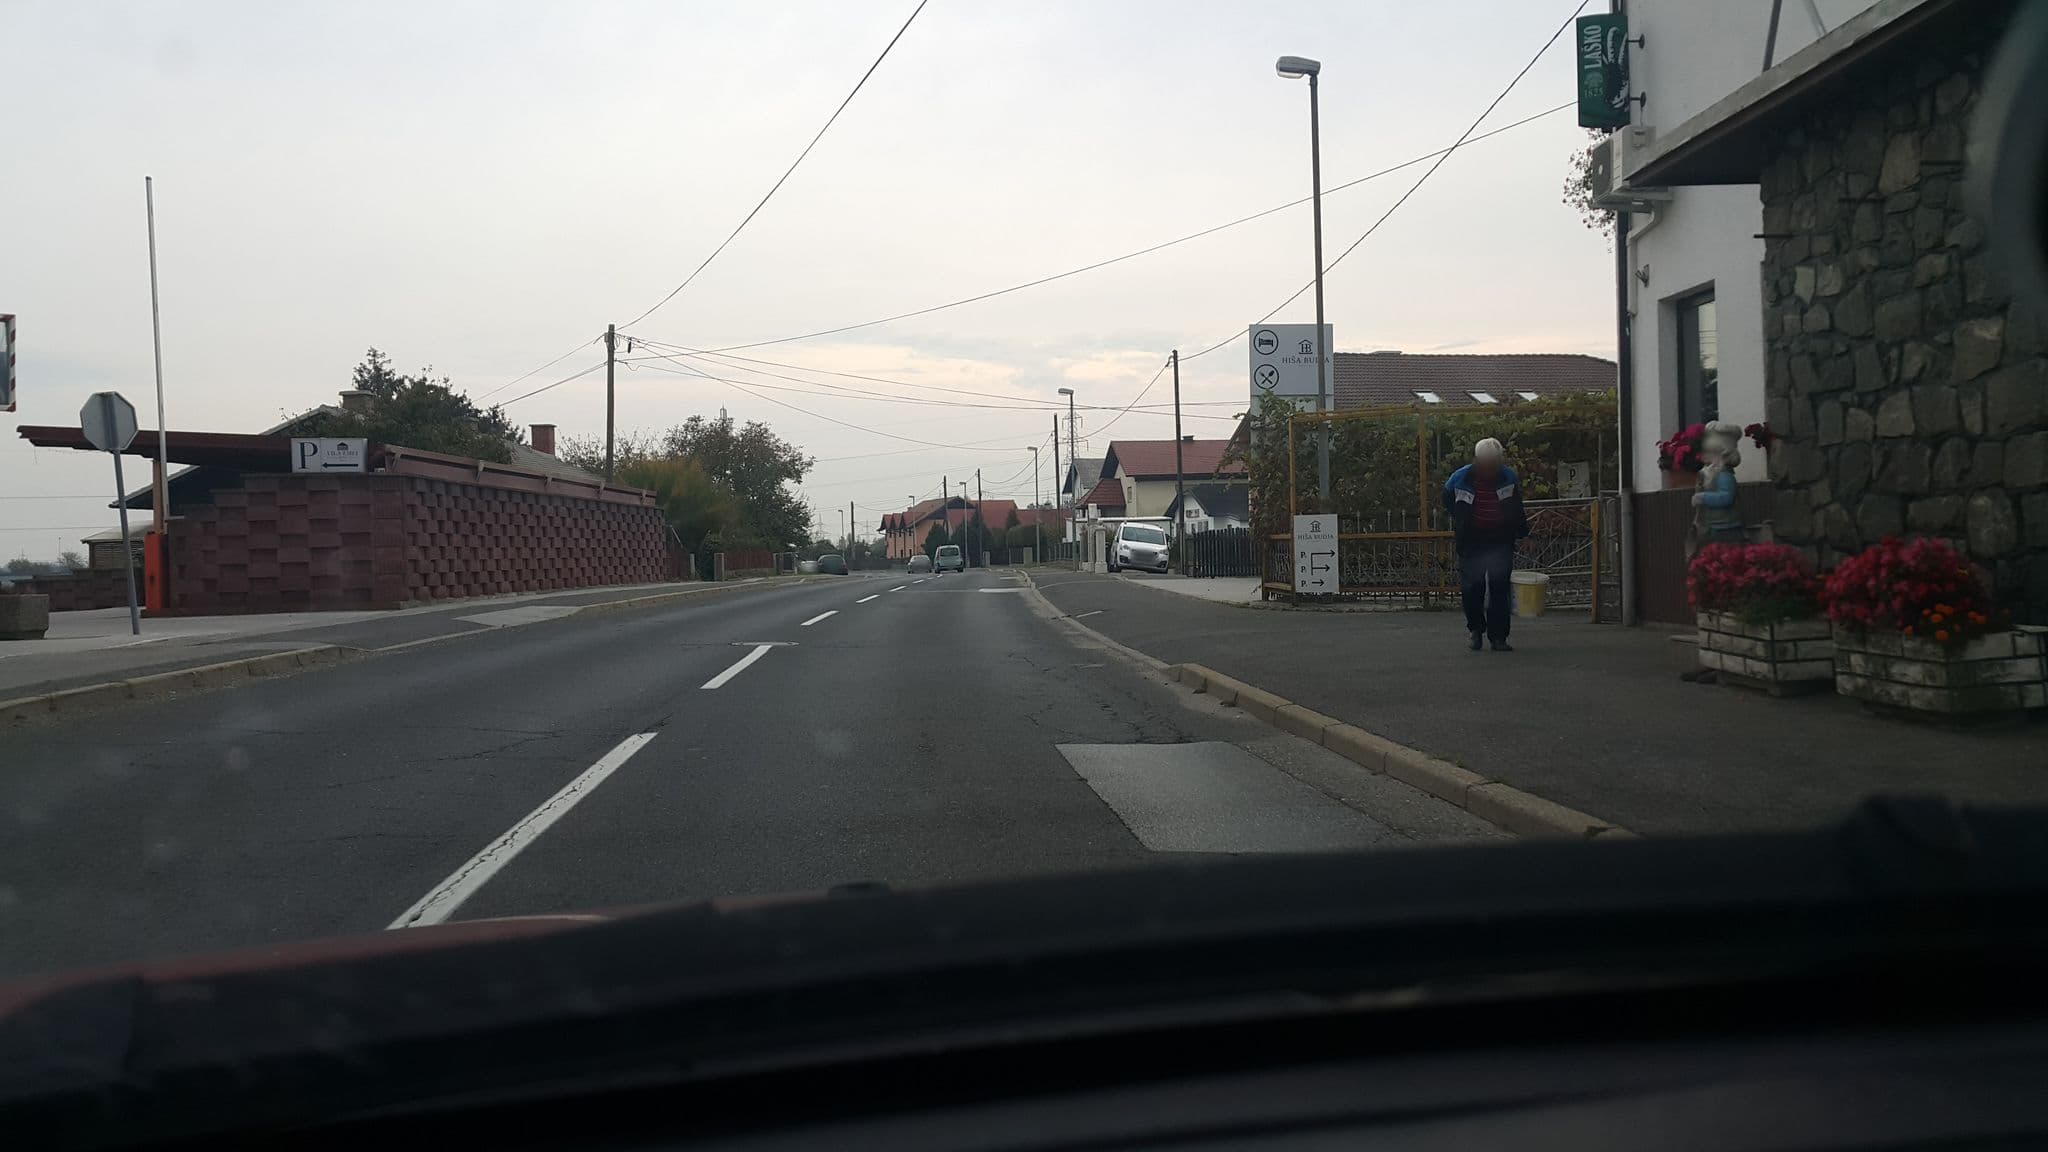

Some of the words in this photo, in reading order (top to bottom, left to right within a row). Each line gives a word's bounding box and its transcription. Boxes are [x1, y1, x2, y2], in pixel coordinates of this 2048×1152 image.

[1582, 25, 1602, 69] LAŠKO
[1282, 355, 1301, 364] HIŠA
[298, 441, 318, 470] P
